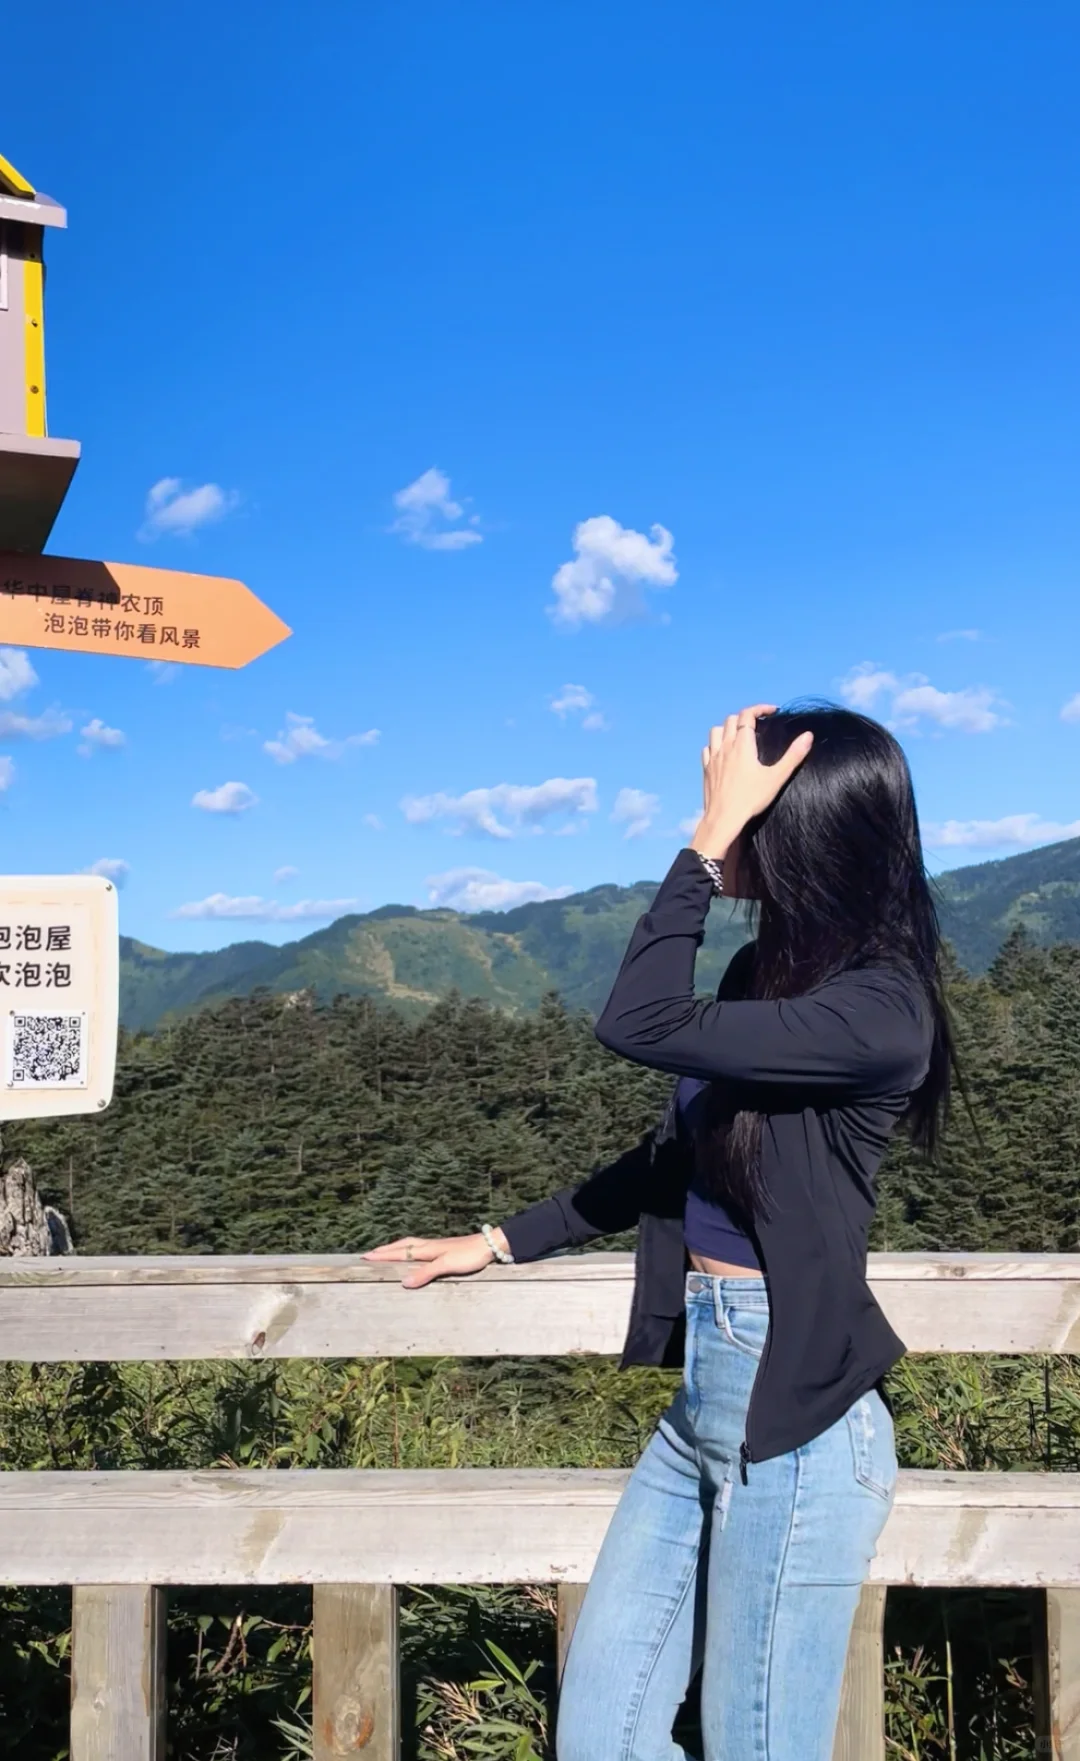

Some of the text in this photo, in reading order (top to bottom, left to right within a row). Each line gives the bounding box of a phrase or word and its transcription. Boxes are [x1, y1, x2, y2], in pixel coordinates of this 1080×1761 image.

[44, 612, 201, 649] 泡泡带你看风景
